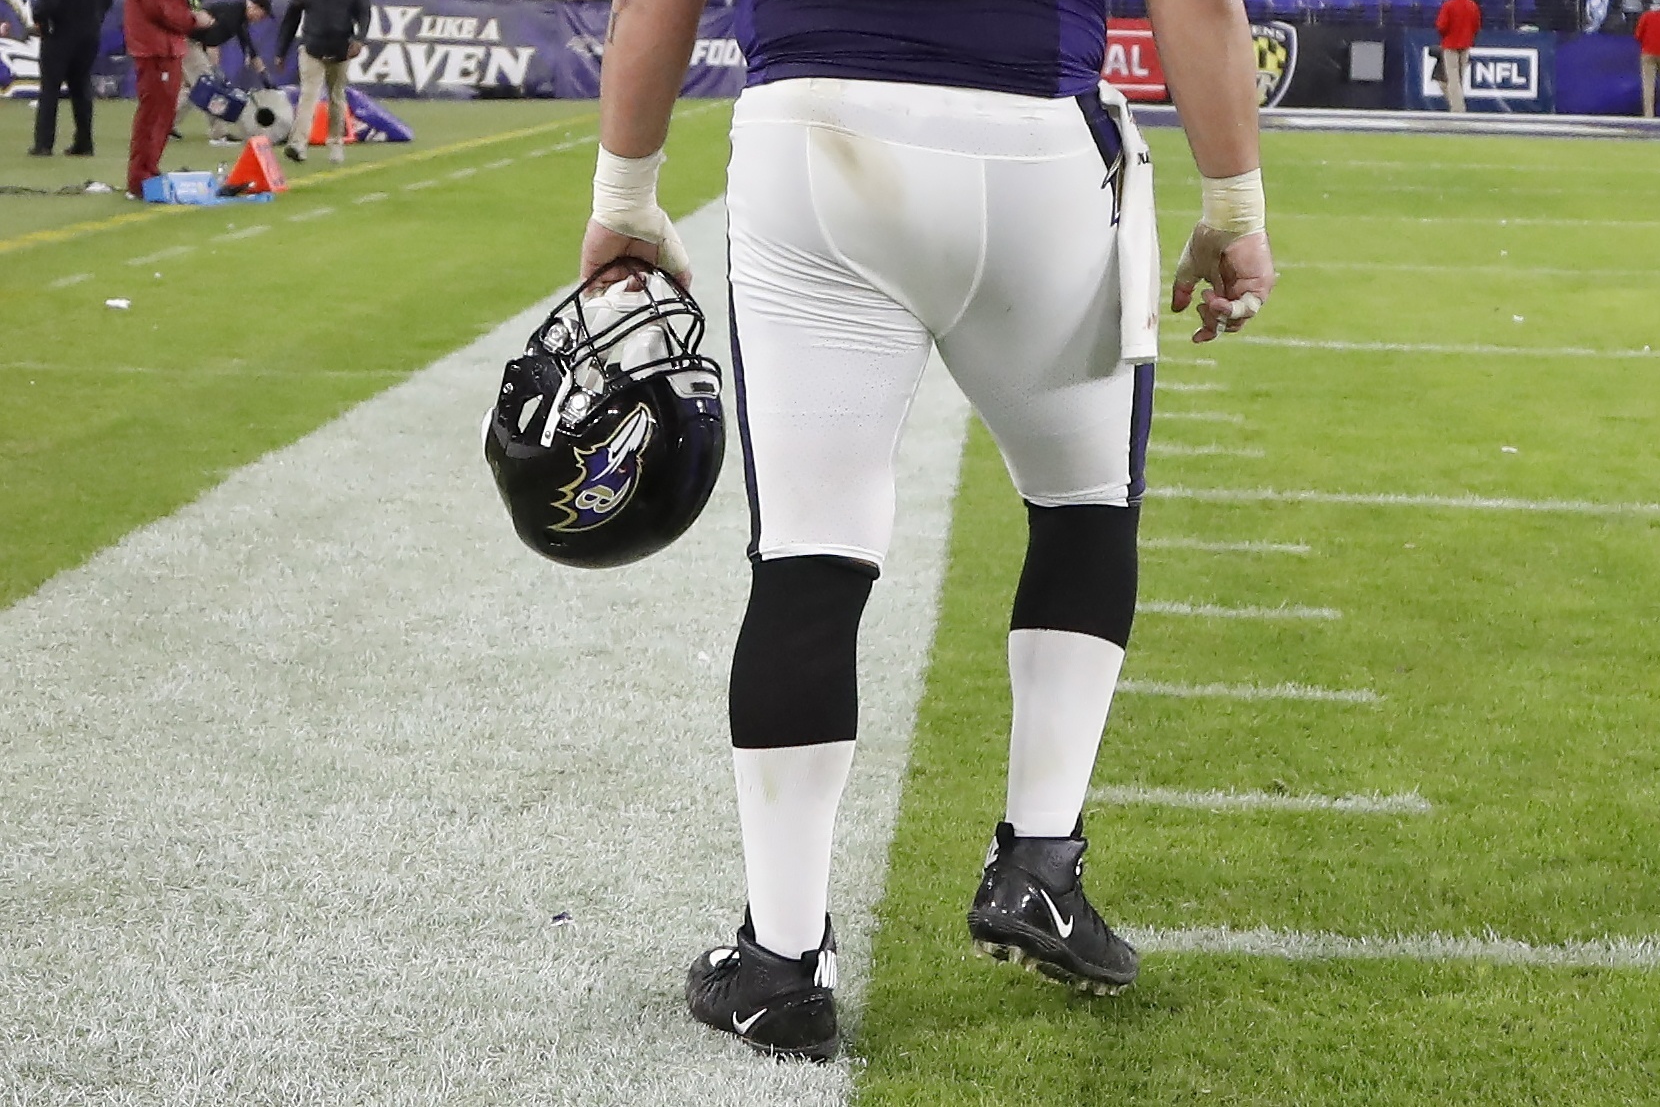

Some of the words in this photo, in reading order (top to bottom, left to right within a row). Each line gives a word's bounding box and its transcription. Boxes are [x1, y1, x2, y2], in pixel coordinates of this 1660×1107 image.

[416, 15, 479, 40] LIKE
[477, 17, 501, 42] A
[1474, 60, 1527, 86] NFL
